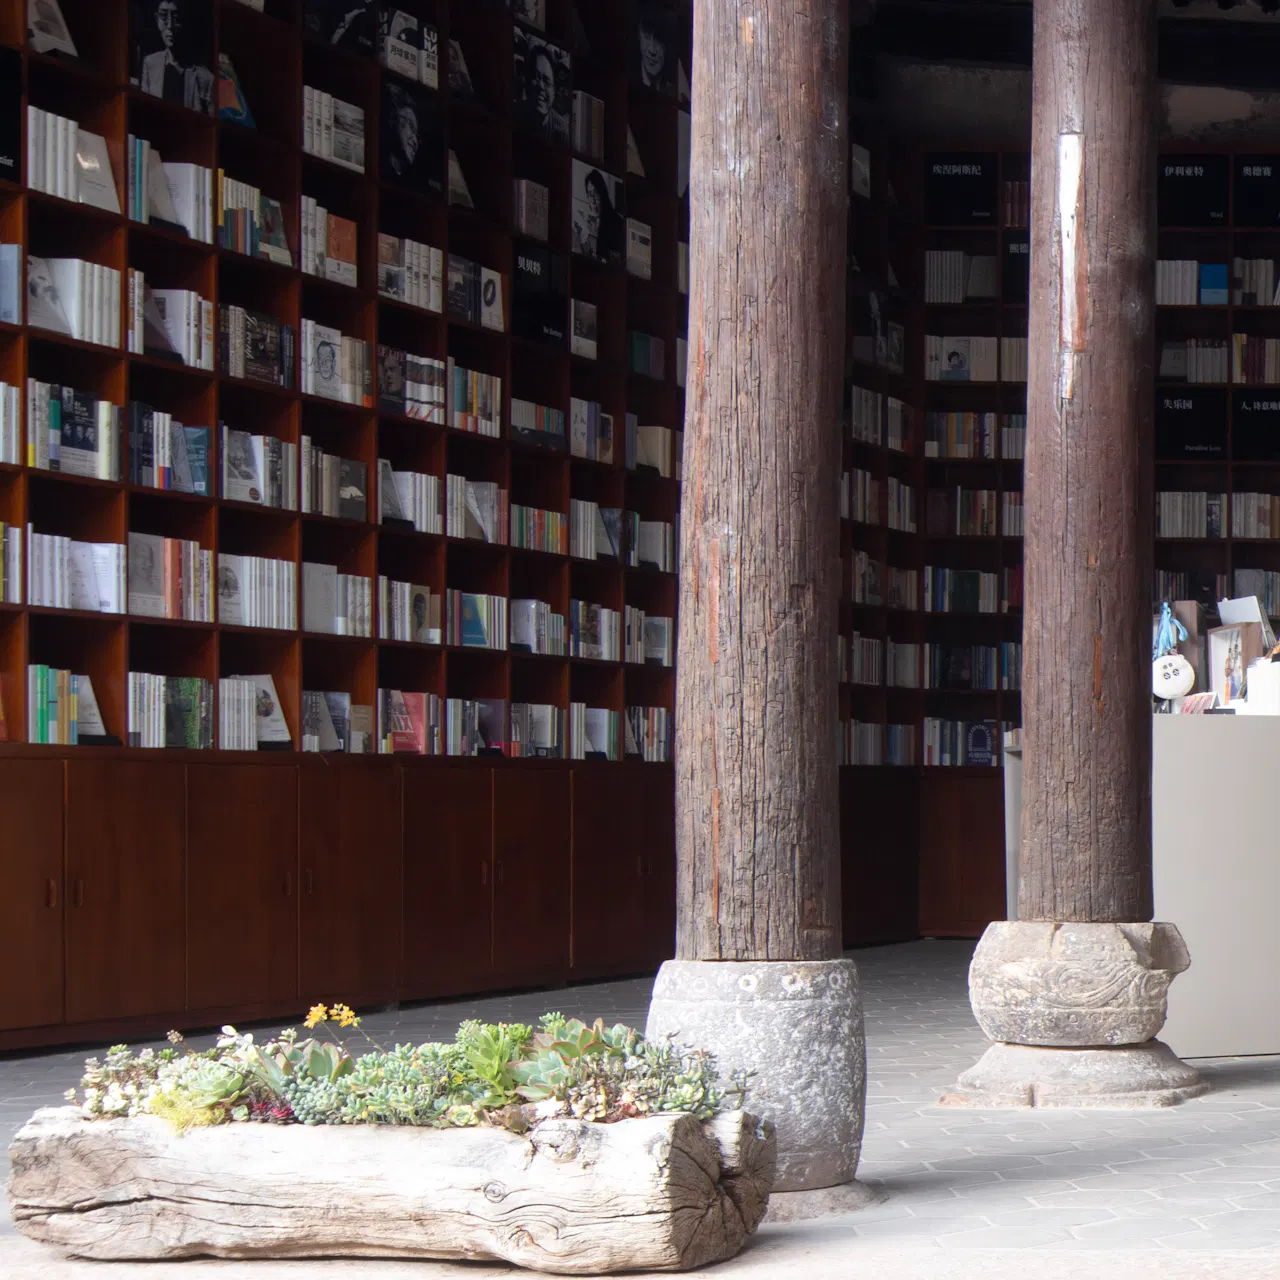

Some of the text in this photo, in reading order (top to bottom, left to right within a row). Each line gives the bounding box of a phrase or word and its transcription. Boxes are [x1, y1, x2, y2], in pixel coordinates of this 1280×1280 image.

[932, 163, 982, 176] 埃涅阿斯纪
[1164, 165, 1205, 177] 伊利亚特
[1242, 165, 1273, 177] 奥德赛
[1163, 398, 1193, 410] 失乐园
